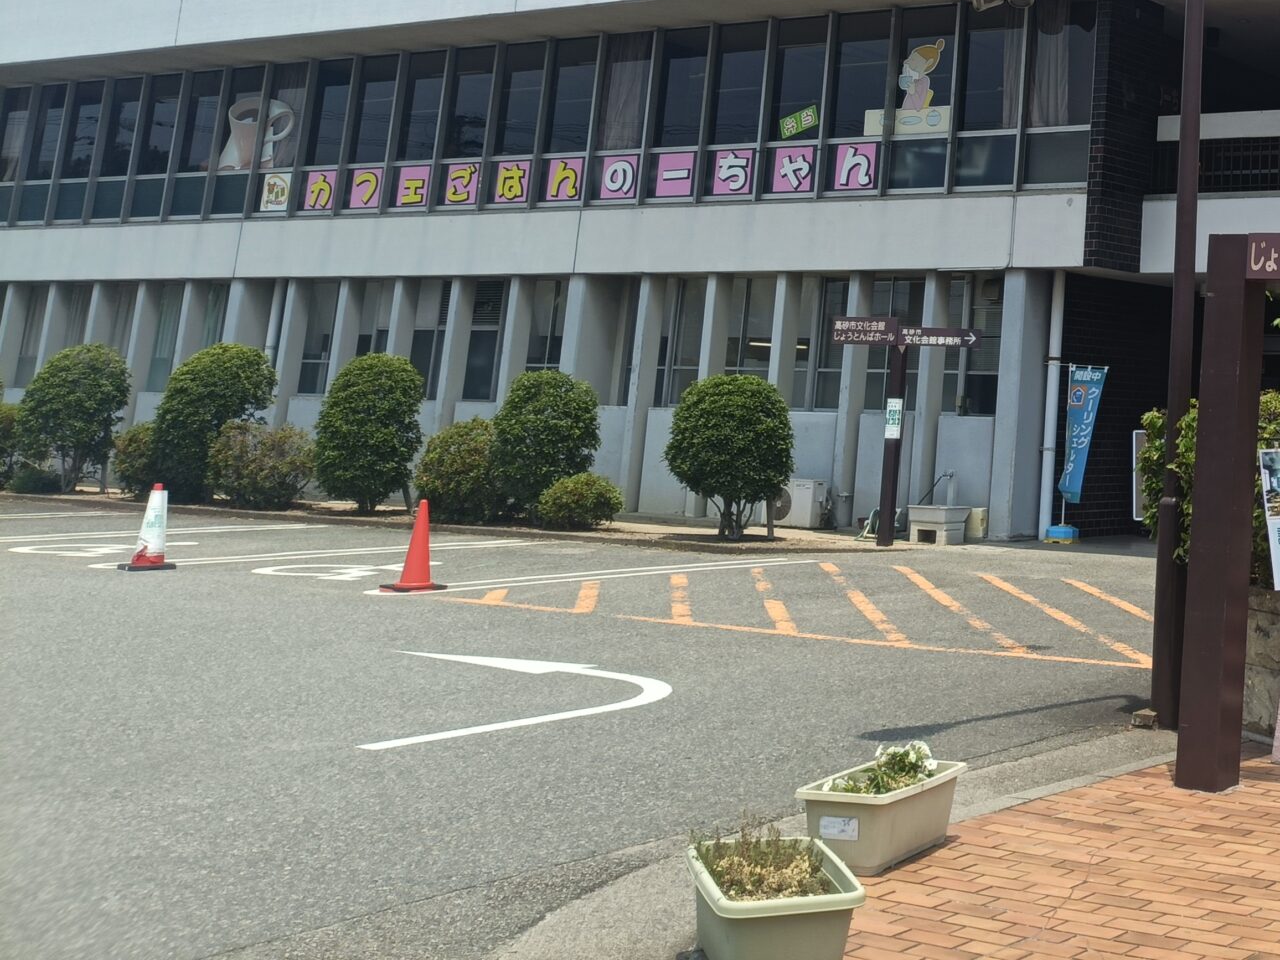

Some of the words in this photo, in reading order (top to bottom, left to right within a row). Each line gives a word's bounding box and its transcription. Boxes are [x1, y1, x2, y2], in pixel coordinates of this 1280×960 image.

[783, 108, 816, 138] 弁当
[834, 320, 886, 331] 高砂市文化会館
[833, 331, 895, 342] じょうとんばホール
[904, 335, 962, 346] 文化会館事務所
[1077, 386, 1100, 449] クーリング
